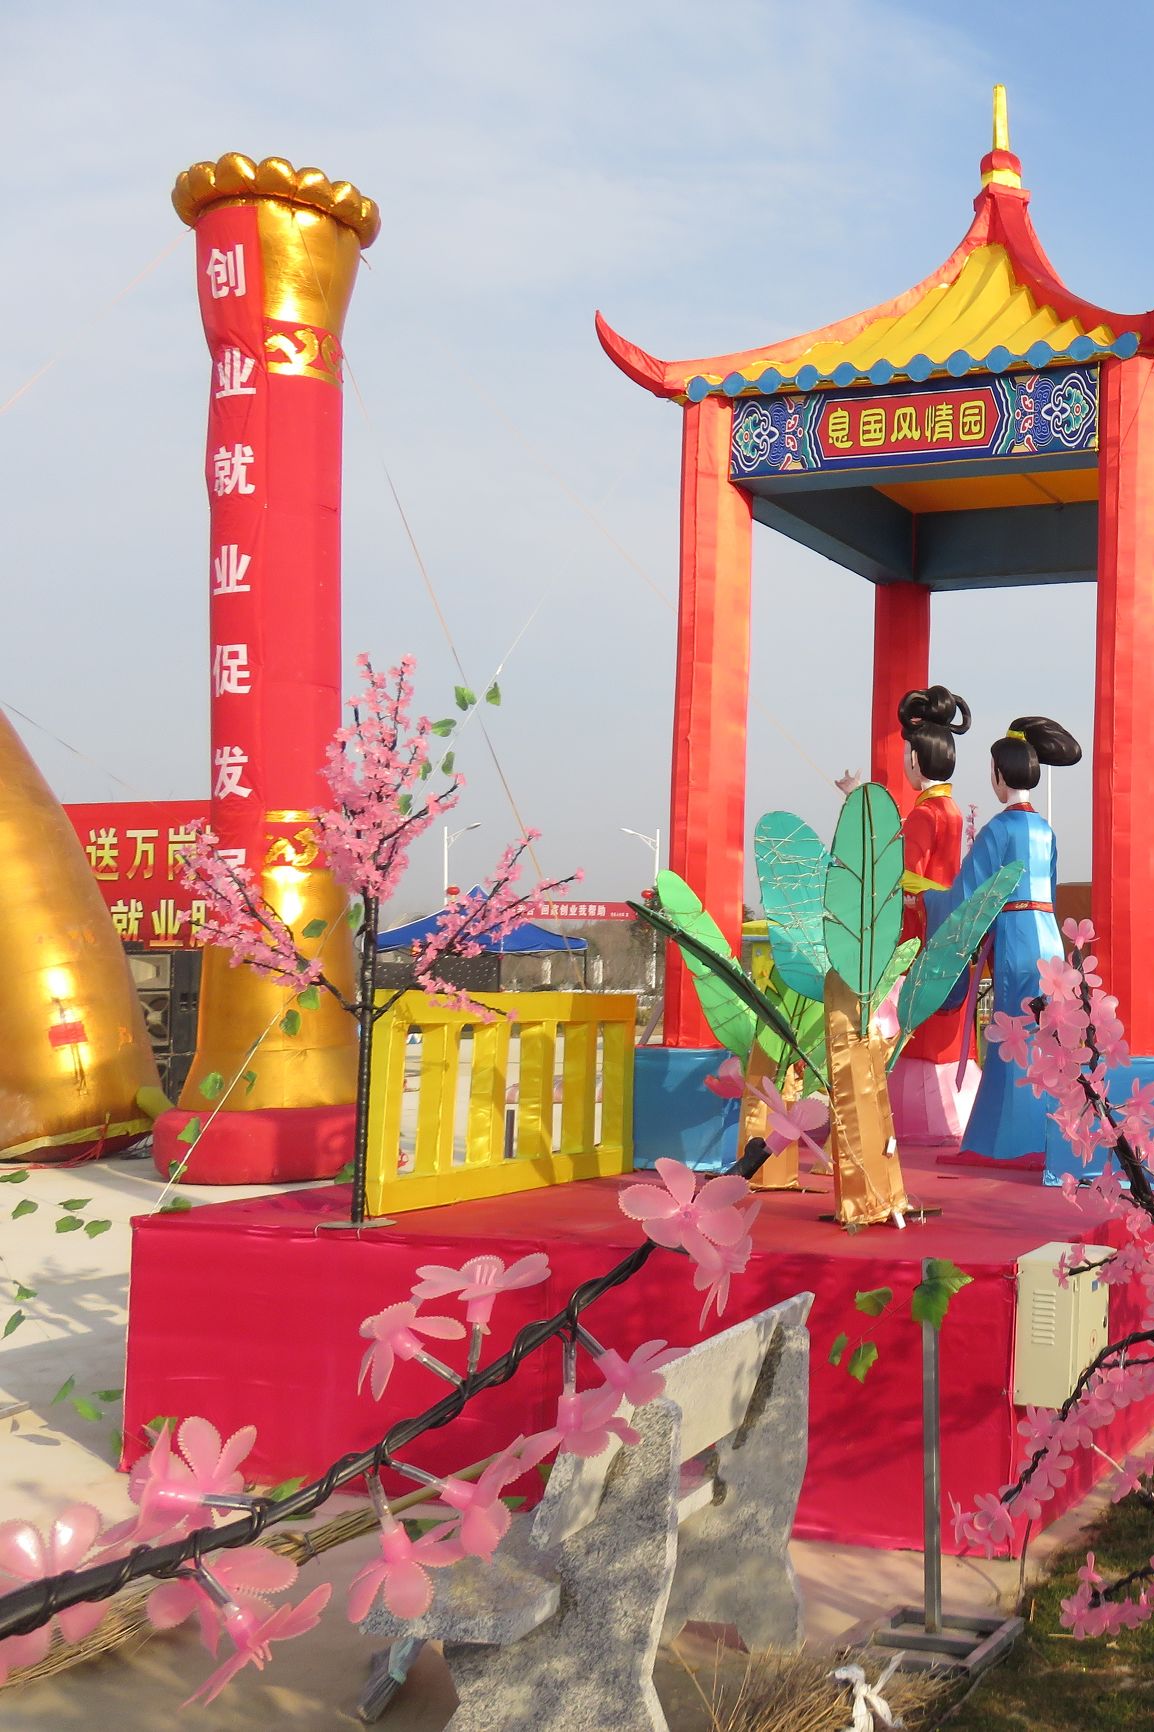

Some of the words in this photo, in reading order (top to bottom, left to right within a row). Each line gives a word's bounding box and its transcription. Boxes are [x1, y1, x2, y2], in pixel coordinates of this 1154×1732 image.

[827, 400, 986, 449] 息国风情园
